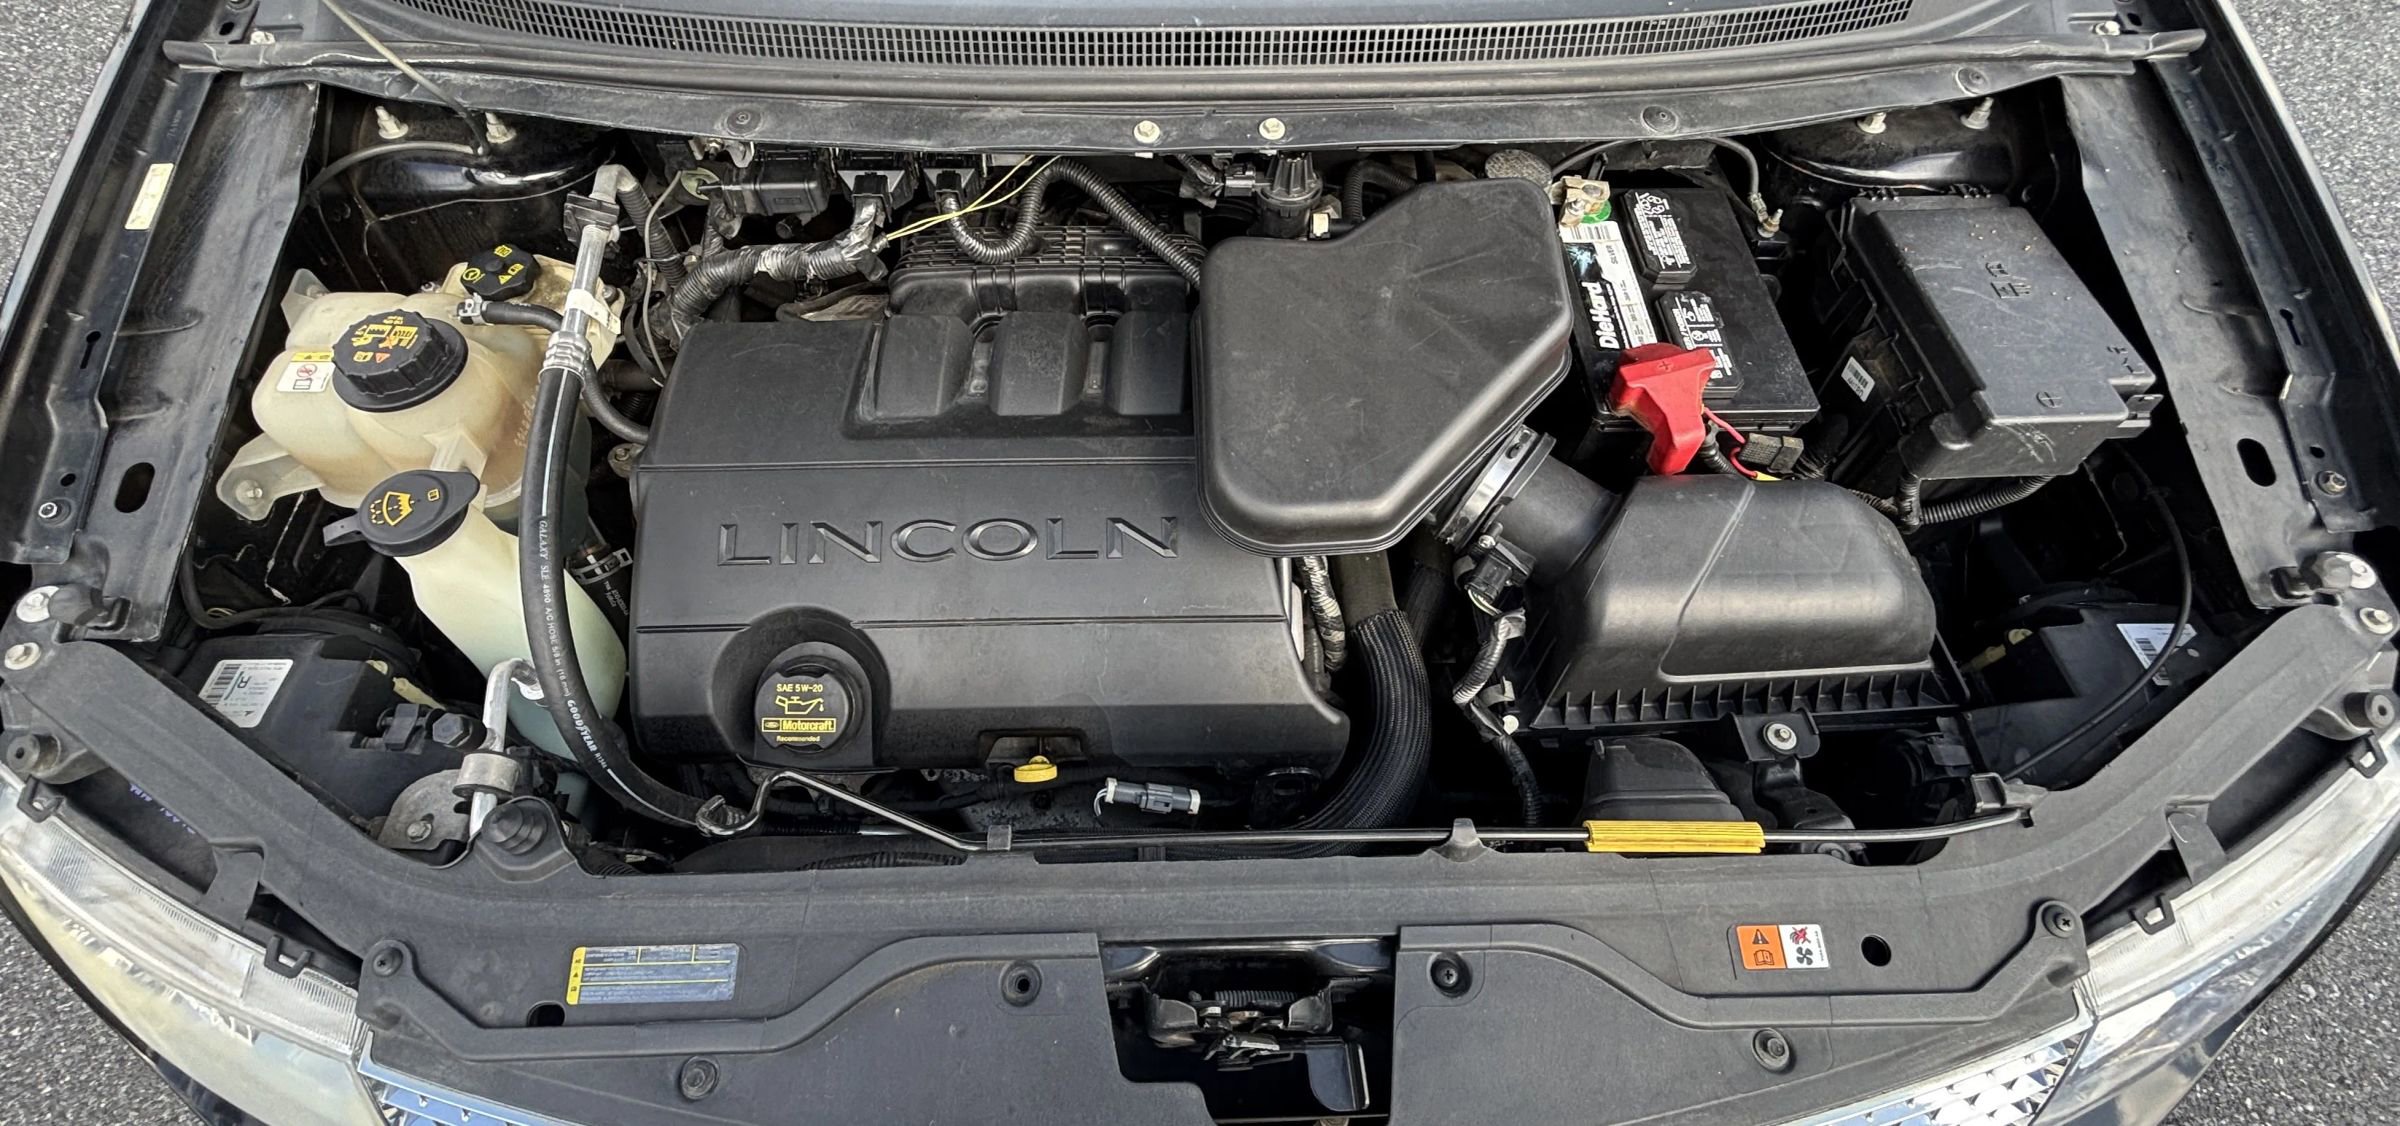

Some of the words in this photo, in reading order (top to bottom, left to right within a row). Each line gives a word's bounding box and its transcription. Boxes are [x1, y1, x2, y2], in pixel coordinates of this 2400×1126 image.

[1581, 281, 1620, 349] DieHard
[1672, 308, 1688, 332] POISON
[539, 520, 549, 560] GALAXY
[717, 517, 1178, 566] LINCOLN
[540, 565, 550, 581] SLE
[542, 584, 552, 604] 4890
[547, 622, 558, 645] HOSE
[776, 683, 793, 692] SAE
[795, 684, 824, 692] 5W-20
[567, 699, 598, 752] GOODYEAR
[782, 720, 833, 731] Motorcraft
